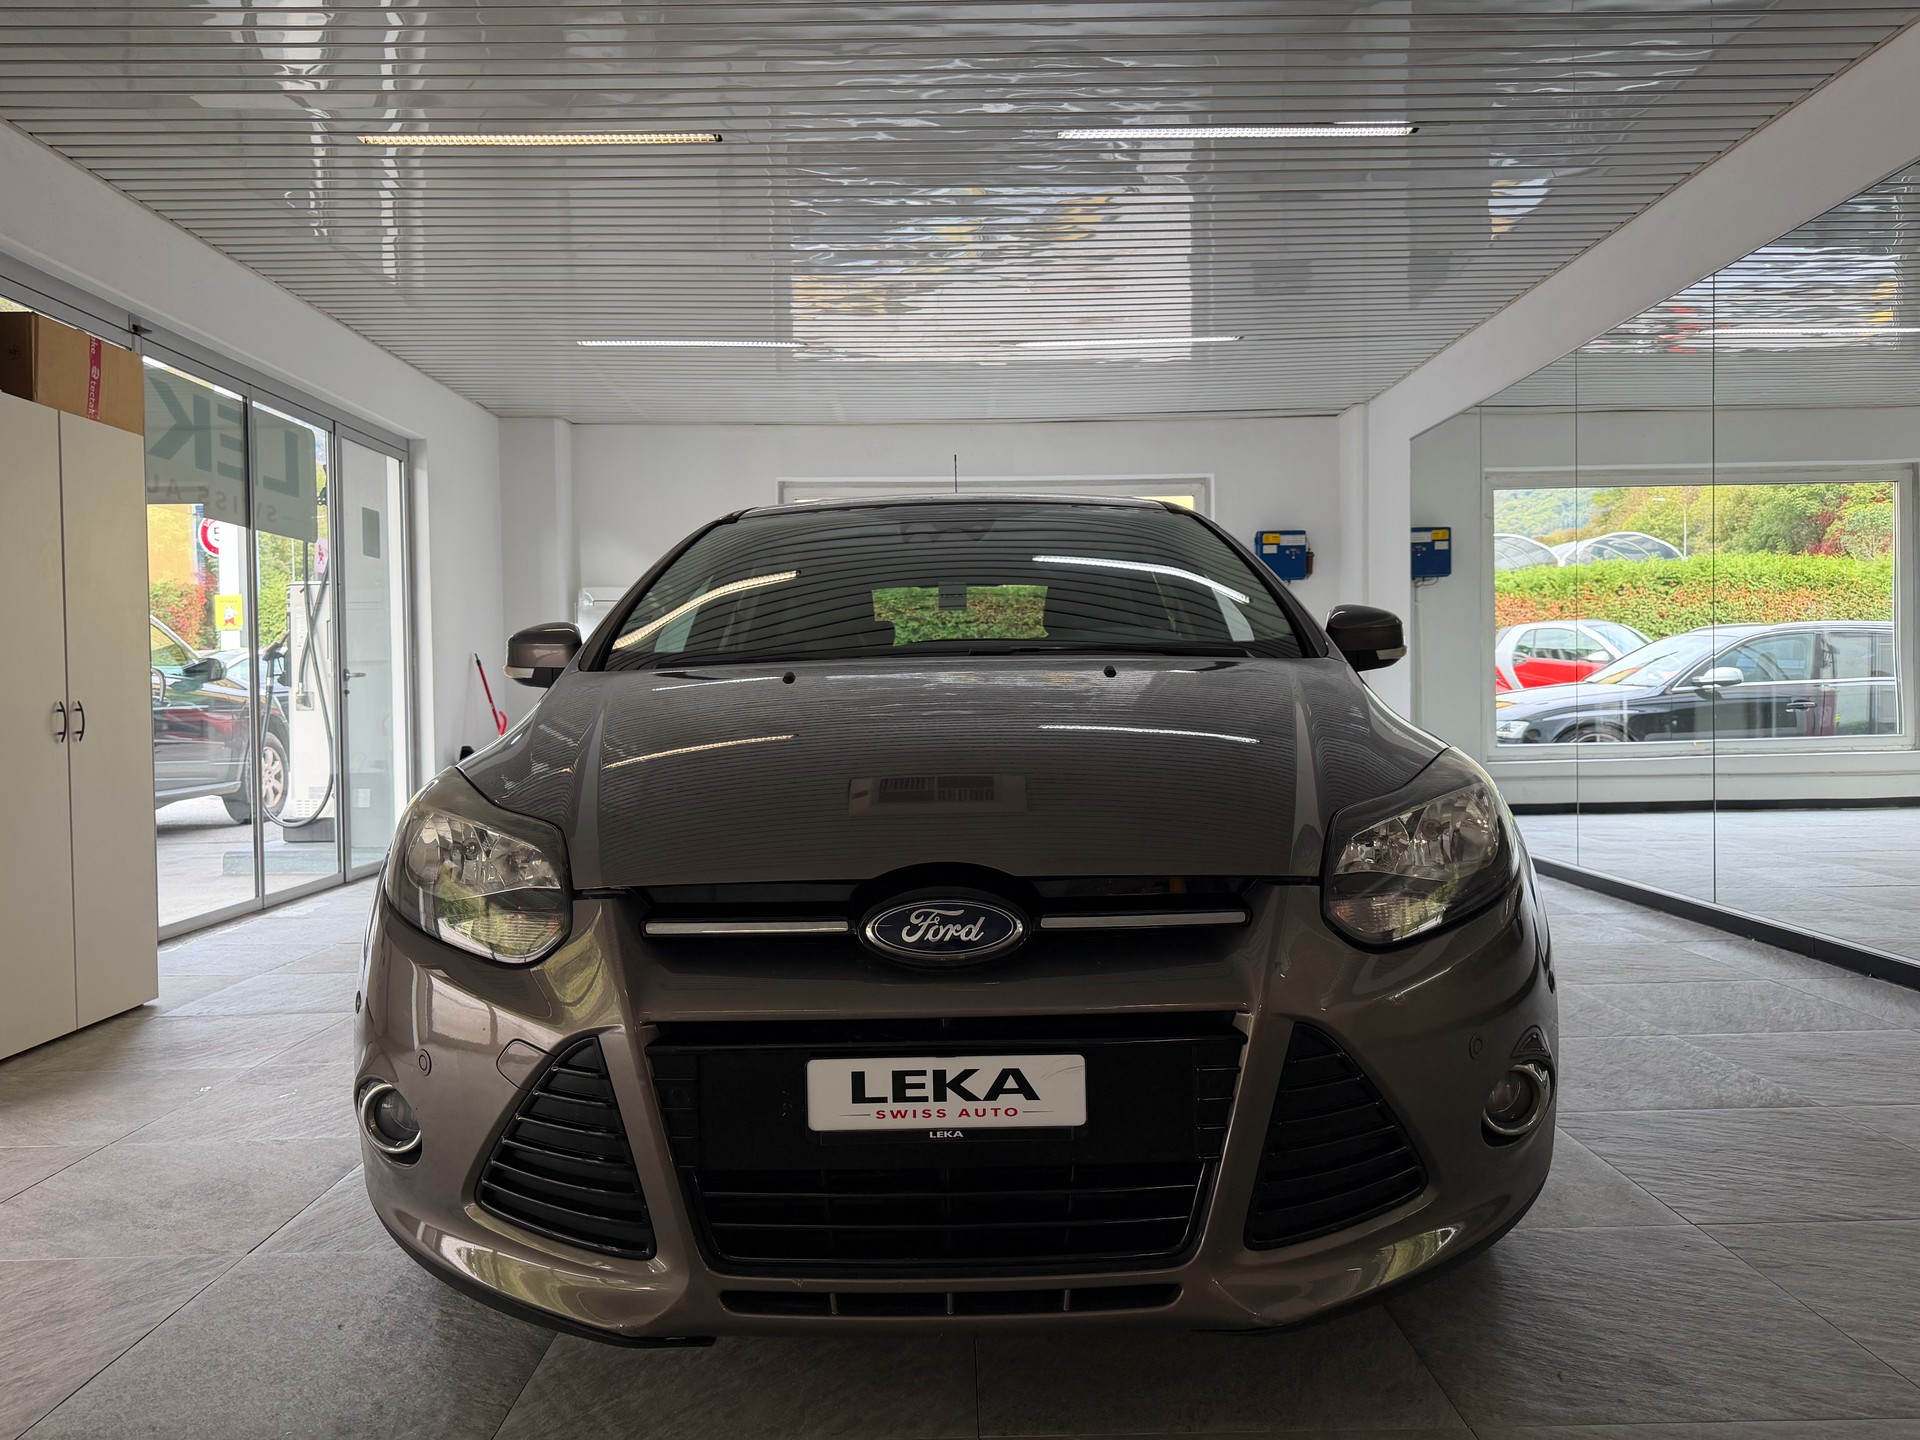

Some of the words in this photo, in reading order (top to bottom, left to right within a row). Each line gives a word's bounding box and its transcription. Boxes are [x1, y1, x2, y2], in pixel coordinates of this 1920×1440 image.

[901, 908, 986, 943] Ford
[850, 1067, 1041, 1104] LEKA
[875, 1108, 947, 1119] SWISS
[958, 1107, 1018, 1118] AUTO
[929, 1130, 964, 1138] LEKA
